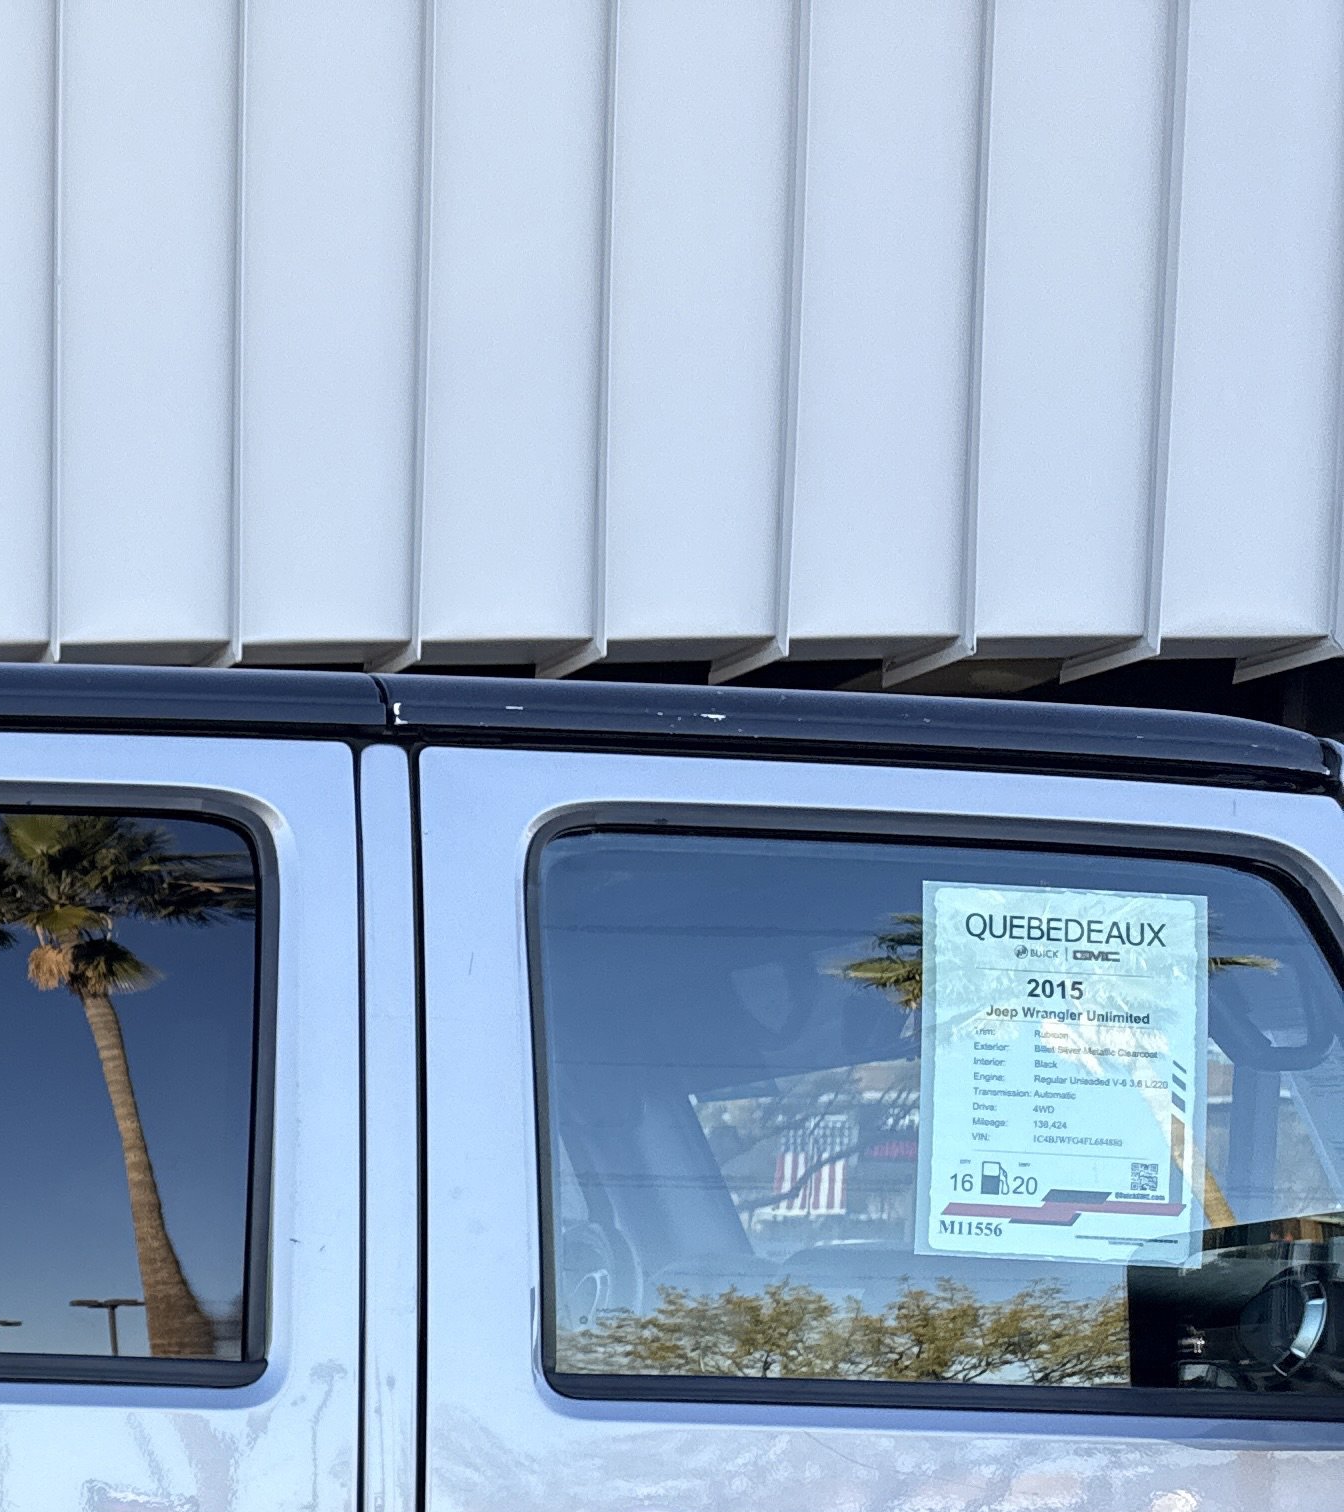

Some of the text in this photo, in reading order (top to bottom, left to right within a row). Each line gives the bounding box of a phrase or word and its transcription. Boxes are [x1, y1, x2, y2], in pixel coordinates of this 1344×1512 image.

[965, 912, 1167, 948] QUEBEDEAUX
[1030, 948, 1121, 962] BUICK GMC
[1026, 978, 1084, 1000] 2015
[986, 1005, 1151, 1025] Jeep Wrangler Unlimited
[973, 1042, 1009, 1052] Exterior:
[1117, 1048, 1159, 1059] Clearcoat
[973, 1057, 1058, 1069] Interior: Black
[973, 1072, 1005, 1083] Engine:
[1034, 1074, 1067, 1085] Regular
[1069, 1076, 1111, 1087] Unleaded
[973, 1087, 1077, 1100] Transmission: Automatic
[972, 1102, 1055, 1114] Drive: 4WD
[972, 1117, 1008, 1128] Mileage:
[972, 1132, 991, 1141] VIN:
[950, 1173, 1038, 1195] 16 20
[938, 1220, 1003, 1237] M11556
